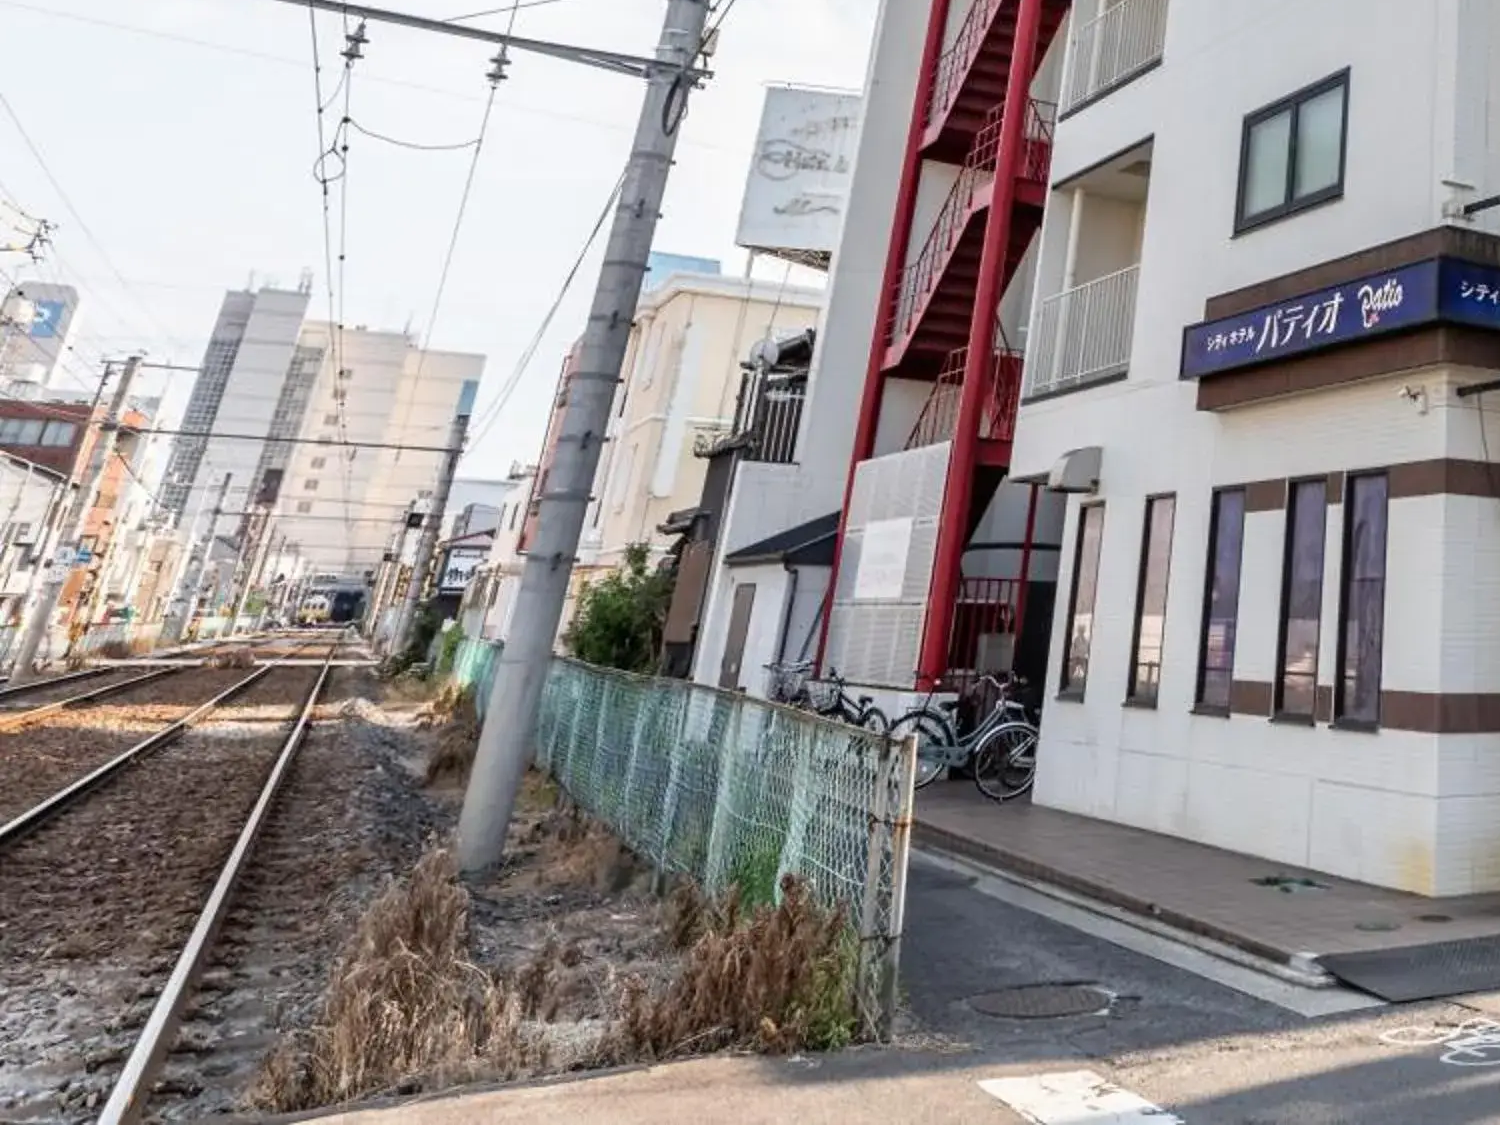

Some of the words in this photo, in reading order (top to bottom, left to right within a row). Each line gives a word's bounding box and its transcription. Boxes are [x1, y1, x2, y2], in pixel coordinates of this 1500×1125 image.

[1256, 291, 1344, 353] パティオ
[1358, 278, 1403, 328] Patio
